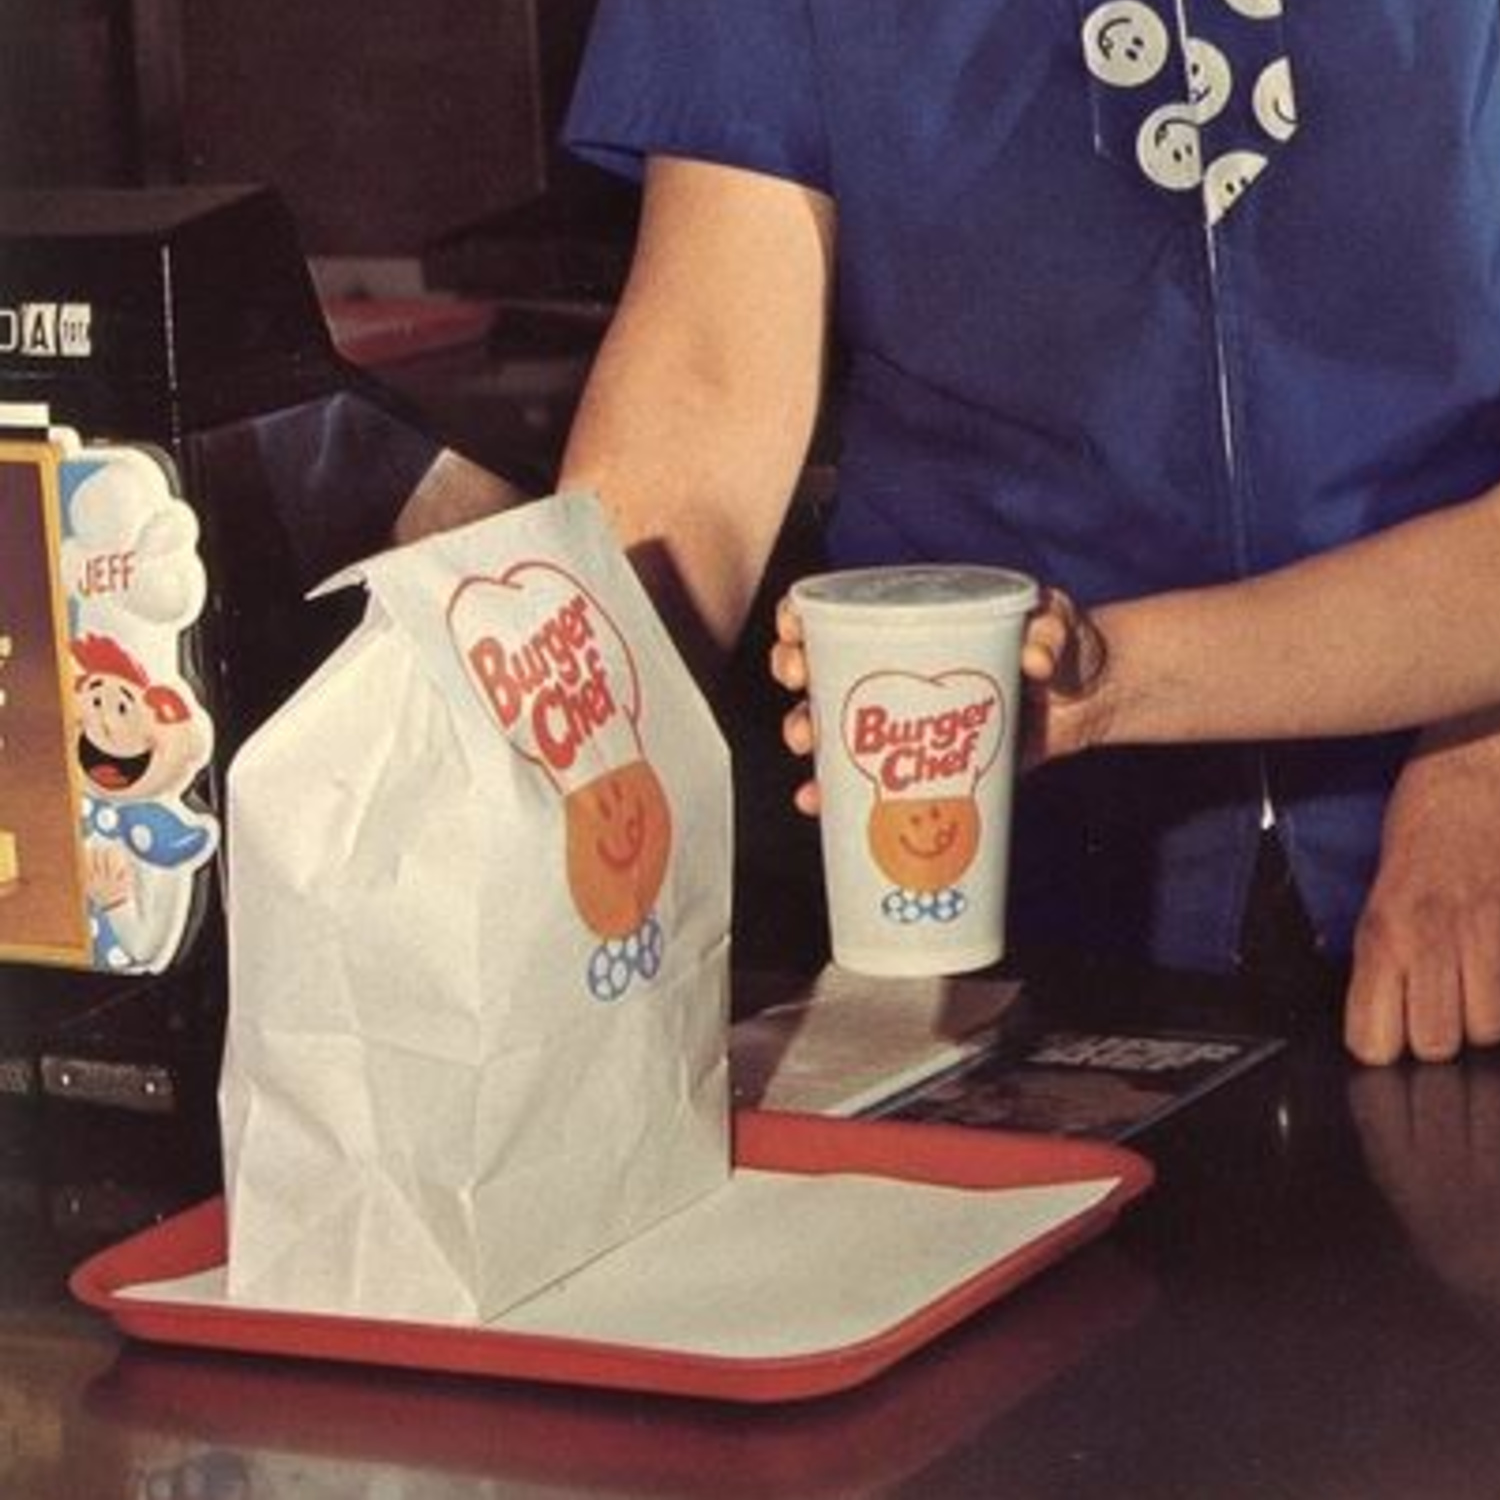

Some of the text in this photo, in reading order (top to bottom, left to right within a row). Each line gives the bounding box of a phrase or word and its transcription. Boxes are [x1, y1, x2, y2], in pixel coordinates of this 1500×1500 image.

[77, 550, 136, 598] JEFF
[468, 594, 595, 729] Burger
[531, 648, 616, 770] Chef
[853, 696, 996, 756] Burger
[880, 730, 980, 792] Chef
